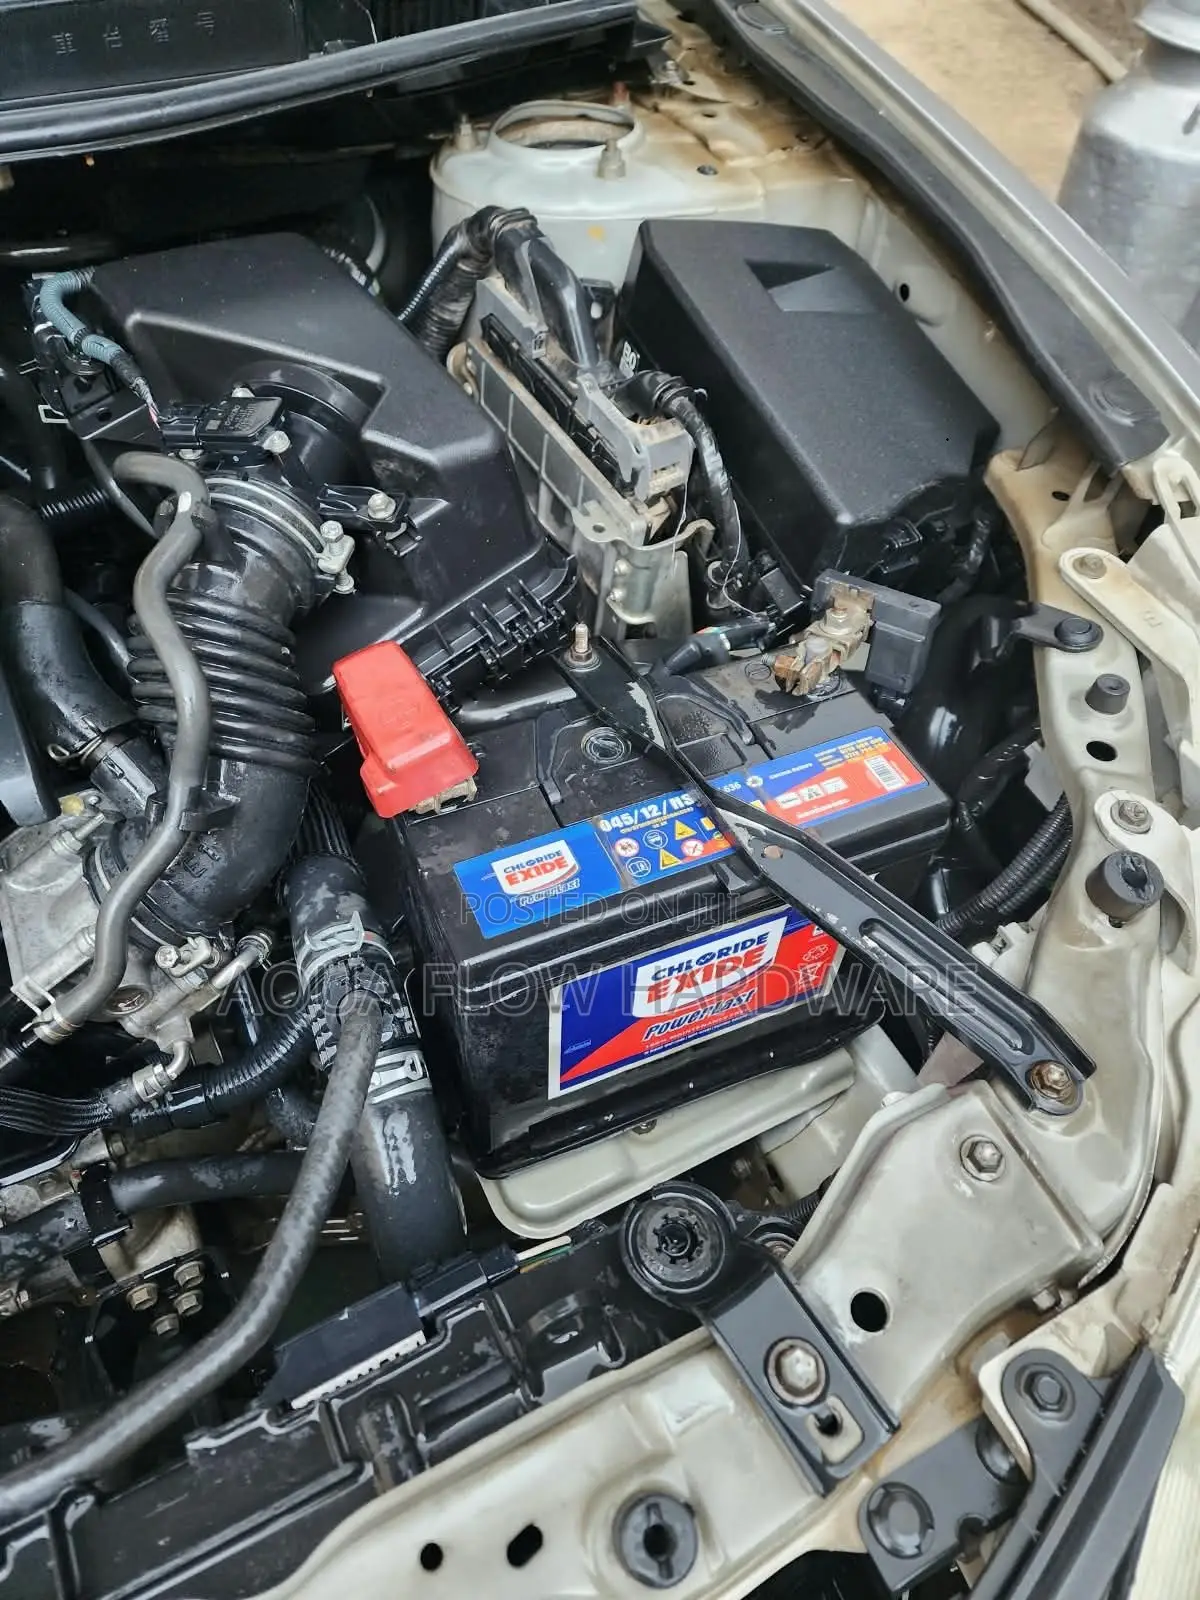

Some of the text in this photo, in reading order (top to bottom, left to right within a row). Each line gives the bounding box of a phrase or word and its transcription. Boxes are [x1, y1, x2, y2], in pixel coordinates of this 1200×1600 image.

[503, 850, 563, 874] CHLORIDE
[505, 856, 569, 887] EXIDE
[646, 944, 768, 1004] EXIDE
[651, 931, 770, 982] CHLORIDE
